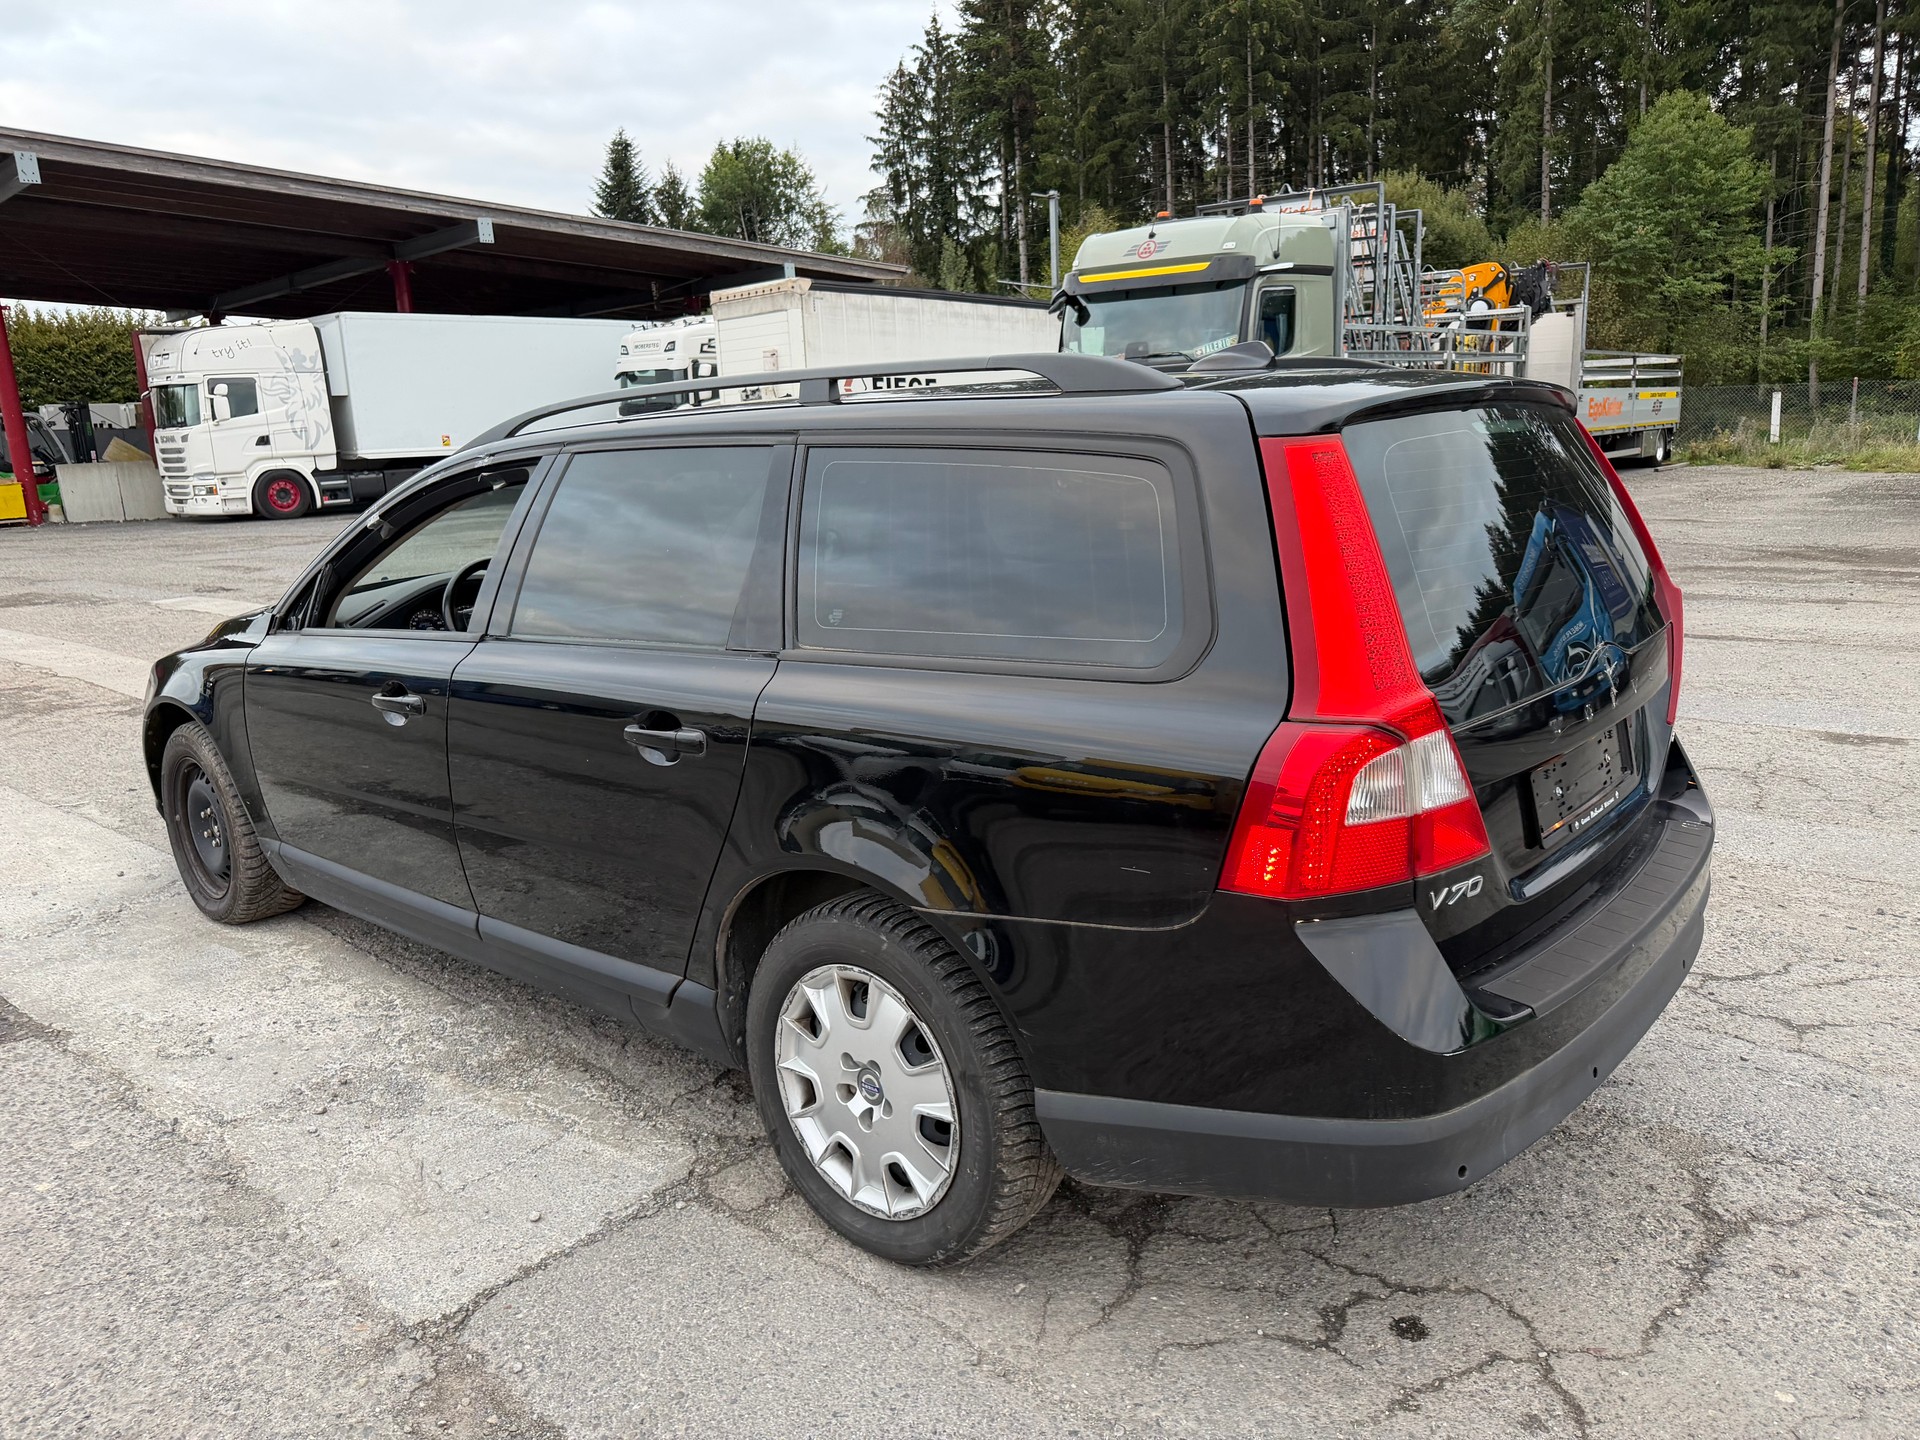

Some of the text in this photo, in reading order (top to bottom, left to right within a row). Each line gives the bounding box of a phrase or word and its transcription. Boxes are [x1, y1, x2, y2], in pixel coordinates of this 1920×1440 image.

[211, 338, 252, 359] try it!
[1429, 875, 1484, 911] V70
